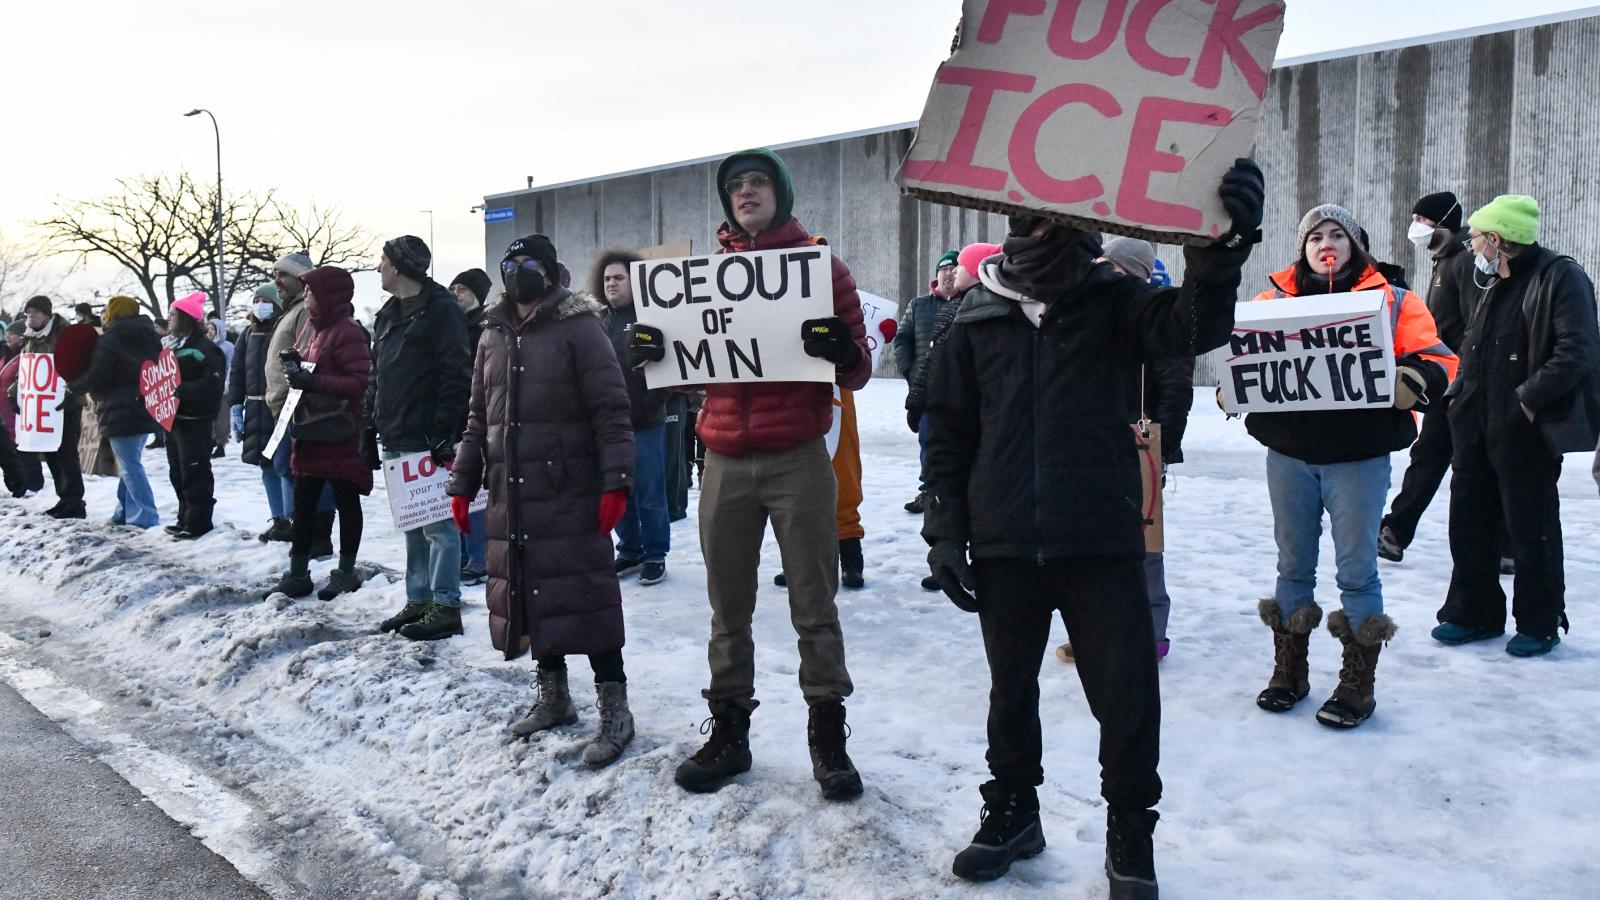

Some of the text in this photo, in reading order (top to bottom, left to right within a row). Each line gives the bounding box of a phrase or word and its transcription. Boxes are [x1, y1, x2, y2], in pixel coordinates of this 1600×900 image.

[976, 0, 1282, 100] FUCK
[638, 251, 821, 309] ICE OUT
[702, 307, 734, 335] OF
[862, 302, 880, 320] ST
[1229, 322, 1372, 356] MN NICE
[142, 351, 177, 391] SOMALIS
[673, 338, 764, 380] MN
[1230, 349, 1390, 405] FUCK ICE
[20, 394, 56, 433] ICE
[144, 388, 160, 409] MAKE
[155, 397, 176, 424] GREAT
[402, 455, 453, 483] LO
[408, 484, 432, 501] your
[429, 502, 451, 512] RELIGIO
